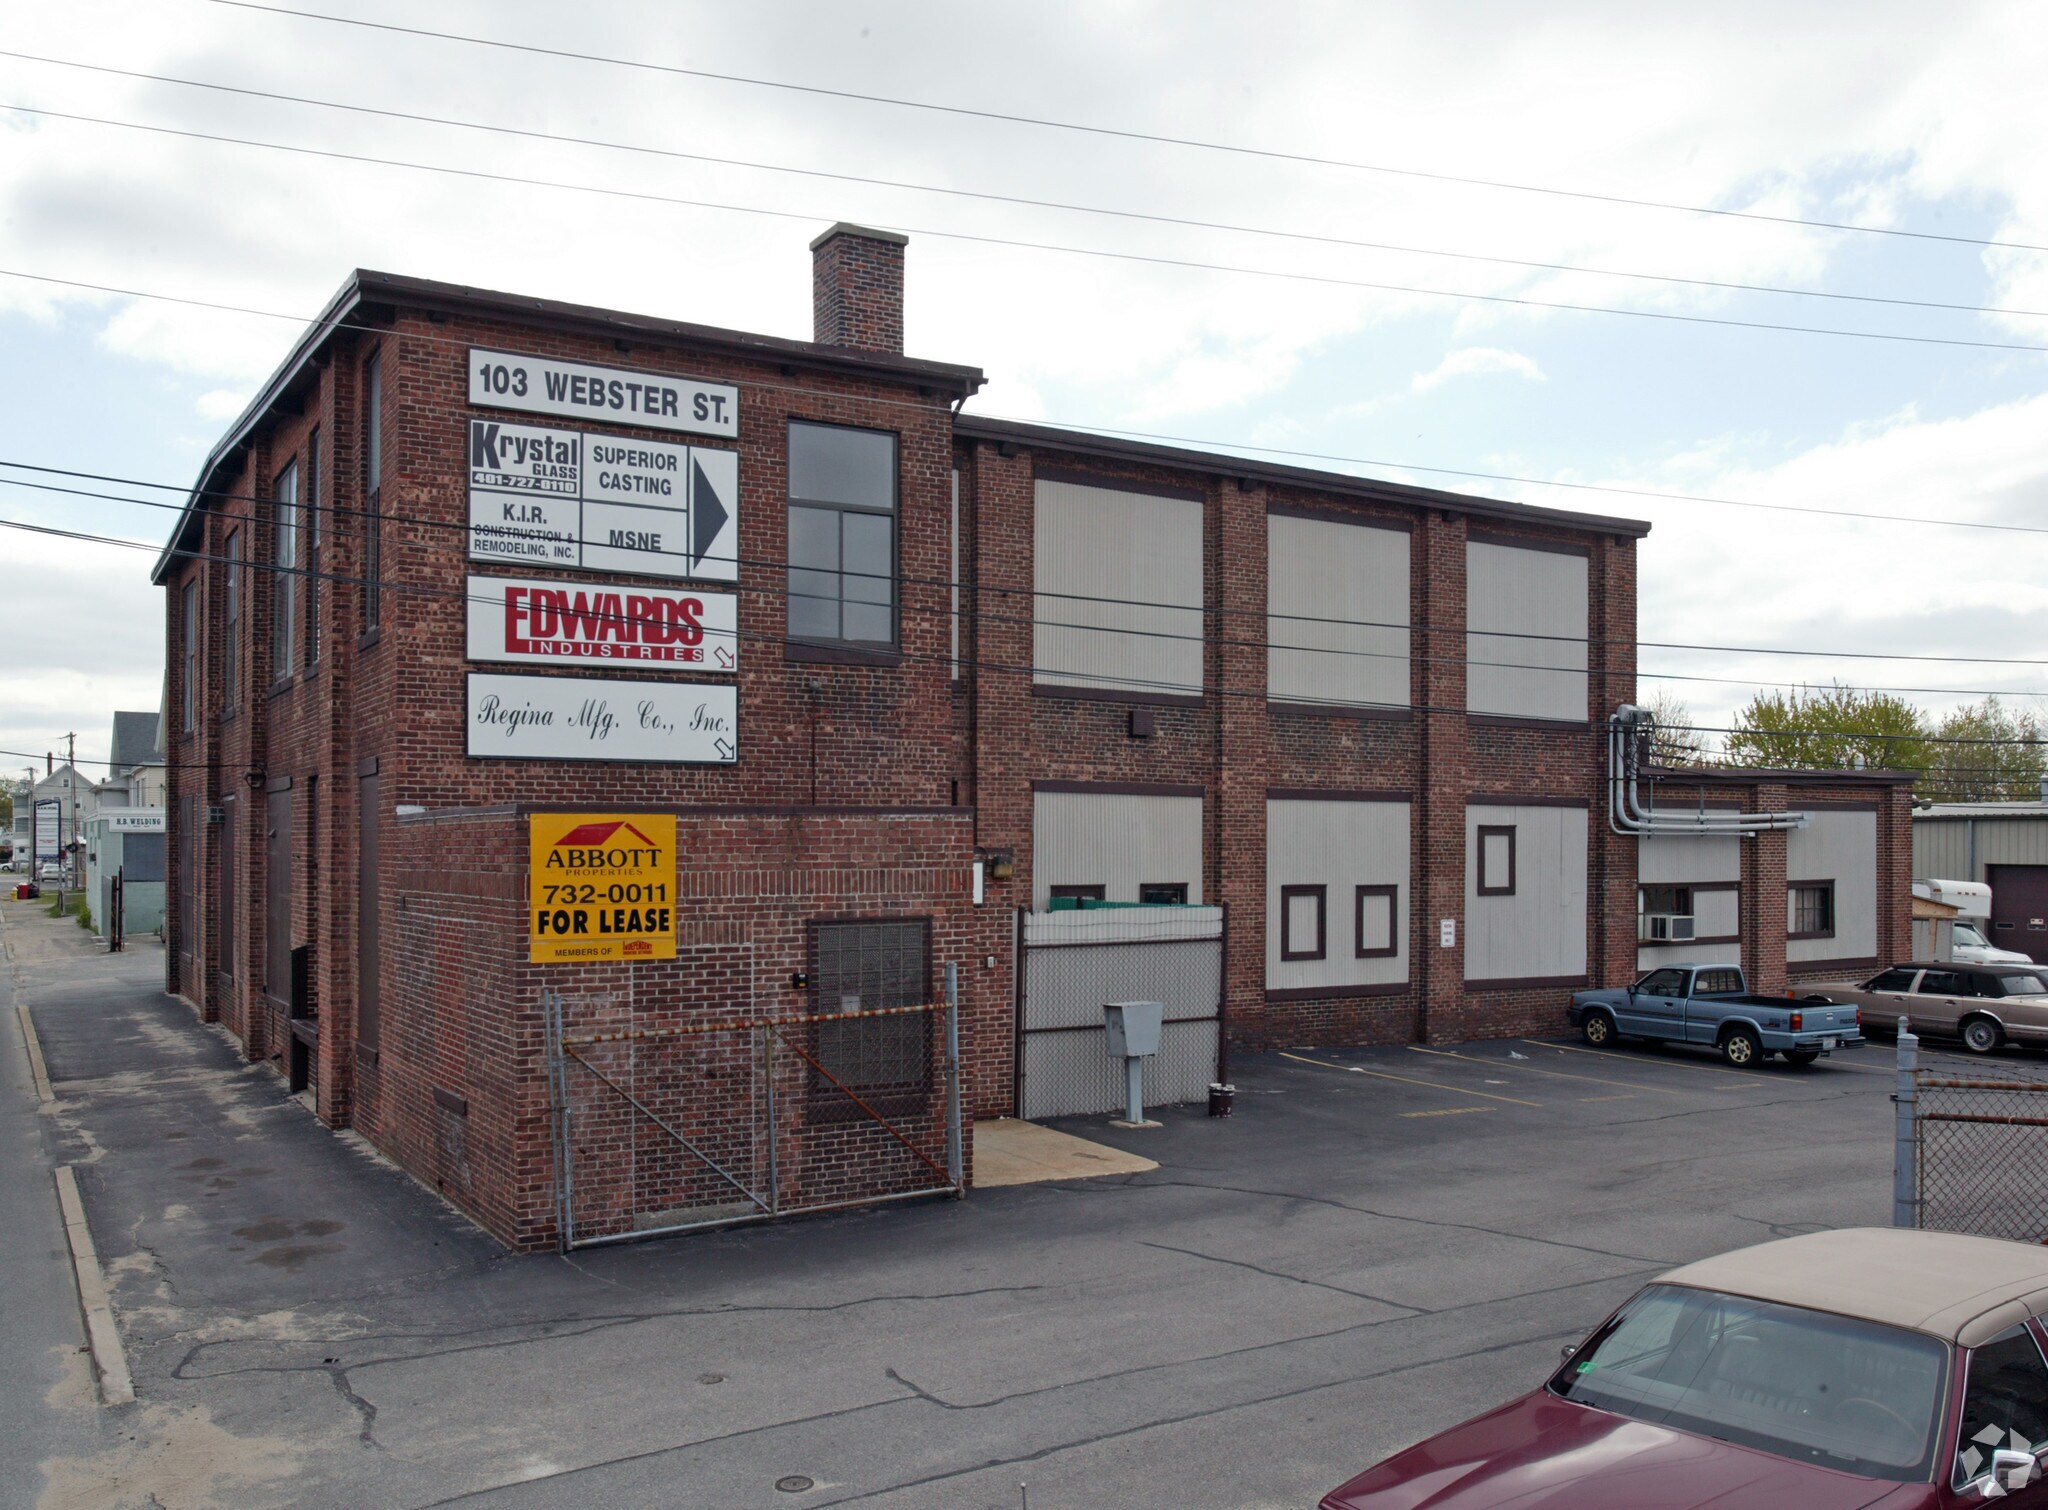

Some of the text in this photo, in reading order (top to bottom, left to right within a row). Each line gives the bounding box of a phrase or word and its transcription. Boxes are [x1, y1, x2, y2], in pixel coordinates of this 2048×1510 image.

[480, 364, 729, 424] 103 WEBSTER ST.
[472, 422, 578, 470] Krystal
[593, 445, 677, 472] SUPERIOR
[532, 463, 577, 480] GLASS
[473, 473, 576, 493] 401-727-0110
[599, 471, 672, 496] CASTING
[503, 503, 547, 524] K.I.R.
[474, 524, 575, 544] CONSTRUCTION &
[609, 529, 662, 551] MSNE
[474, 539, 575, 559] REMODELING, INC.
[505, 586, 704, 648] EDWARDS
[528, 640, 704, 662] INDUSTRIES
[477, 694, 729, 740] Regina Mfg. Co., Inc.
[545, 849, 662, 868] ABBOTT
[543, 883, 666, 905] 732-0011
[538, 908, 670, 935] FOR LEASE
[555, 948, 599, 957] MEMBERS
[601, 948, 613, 956] OF
